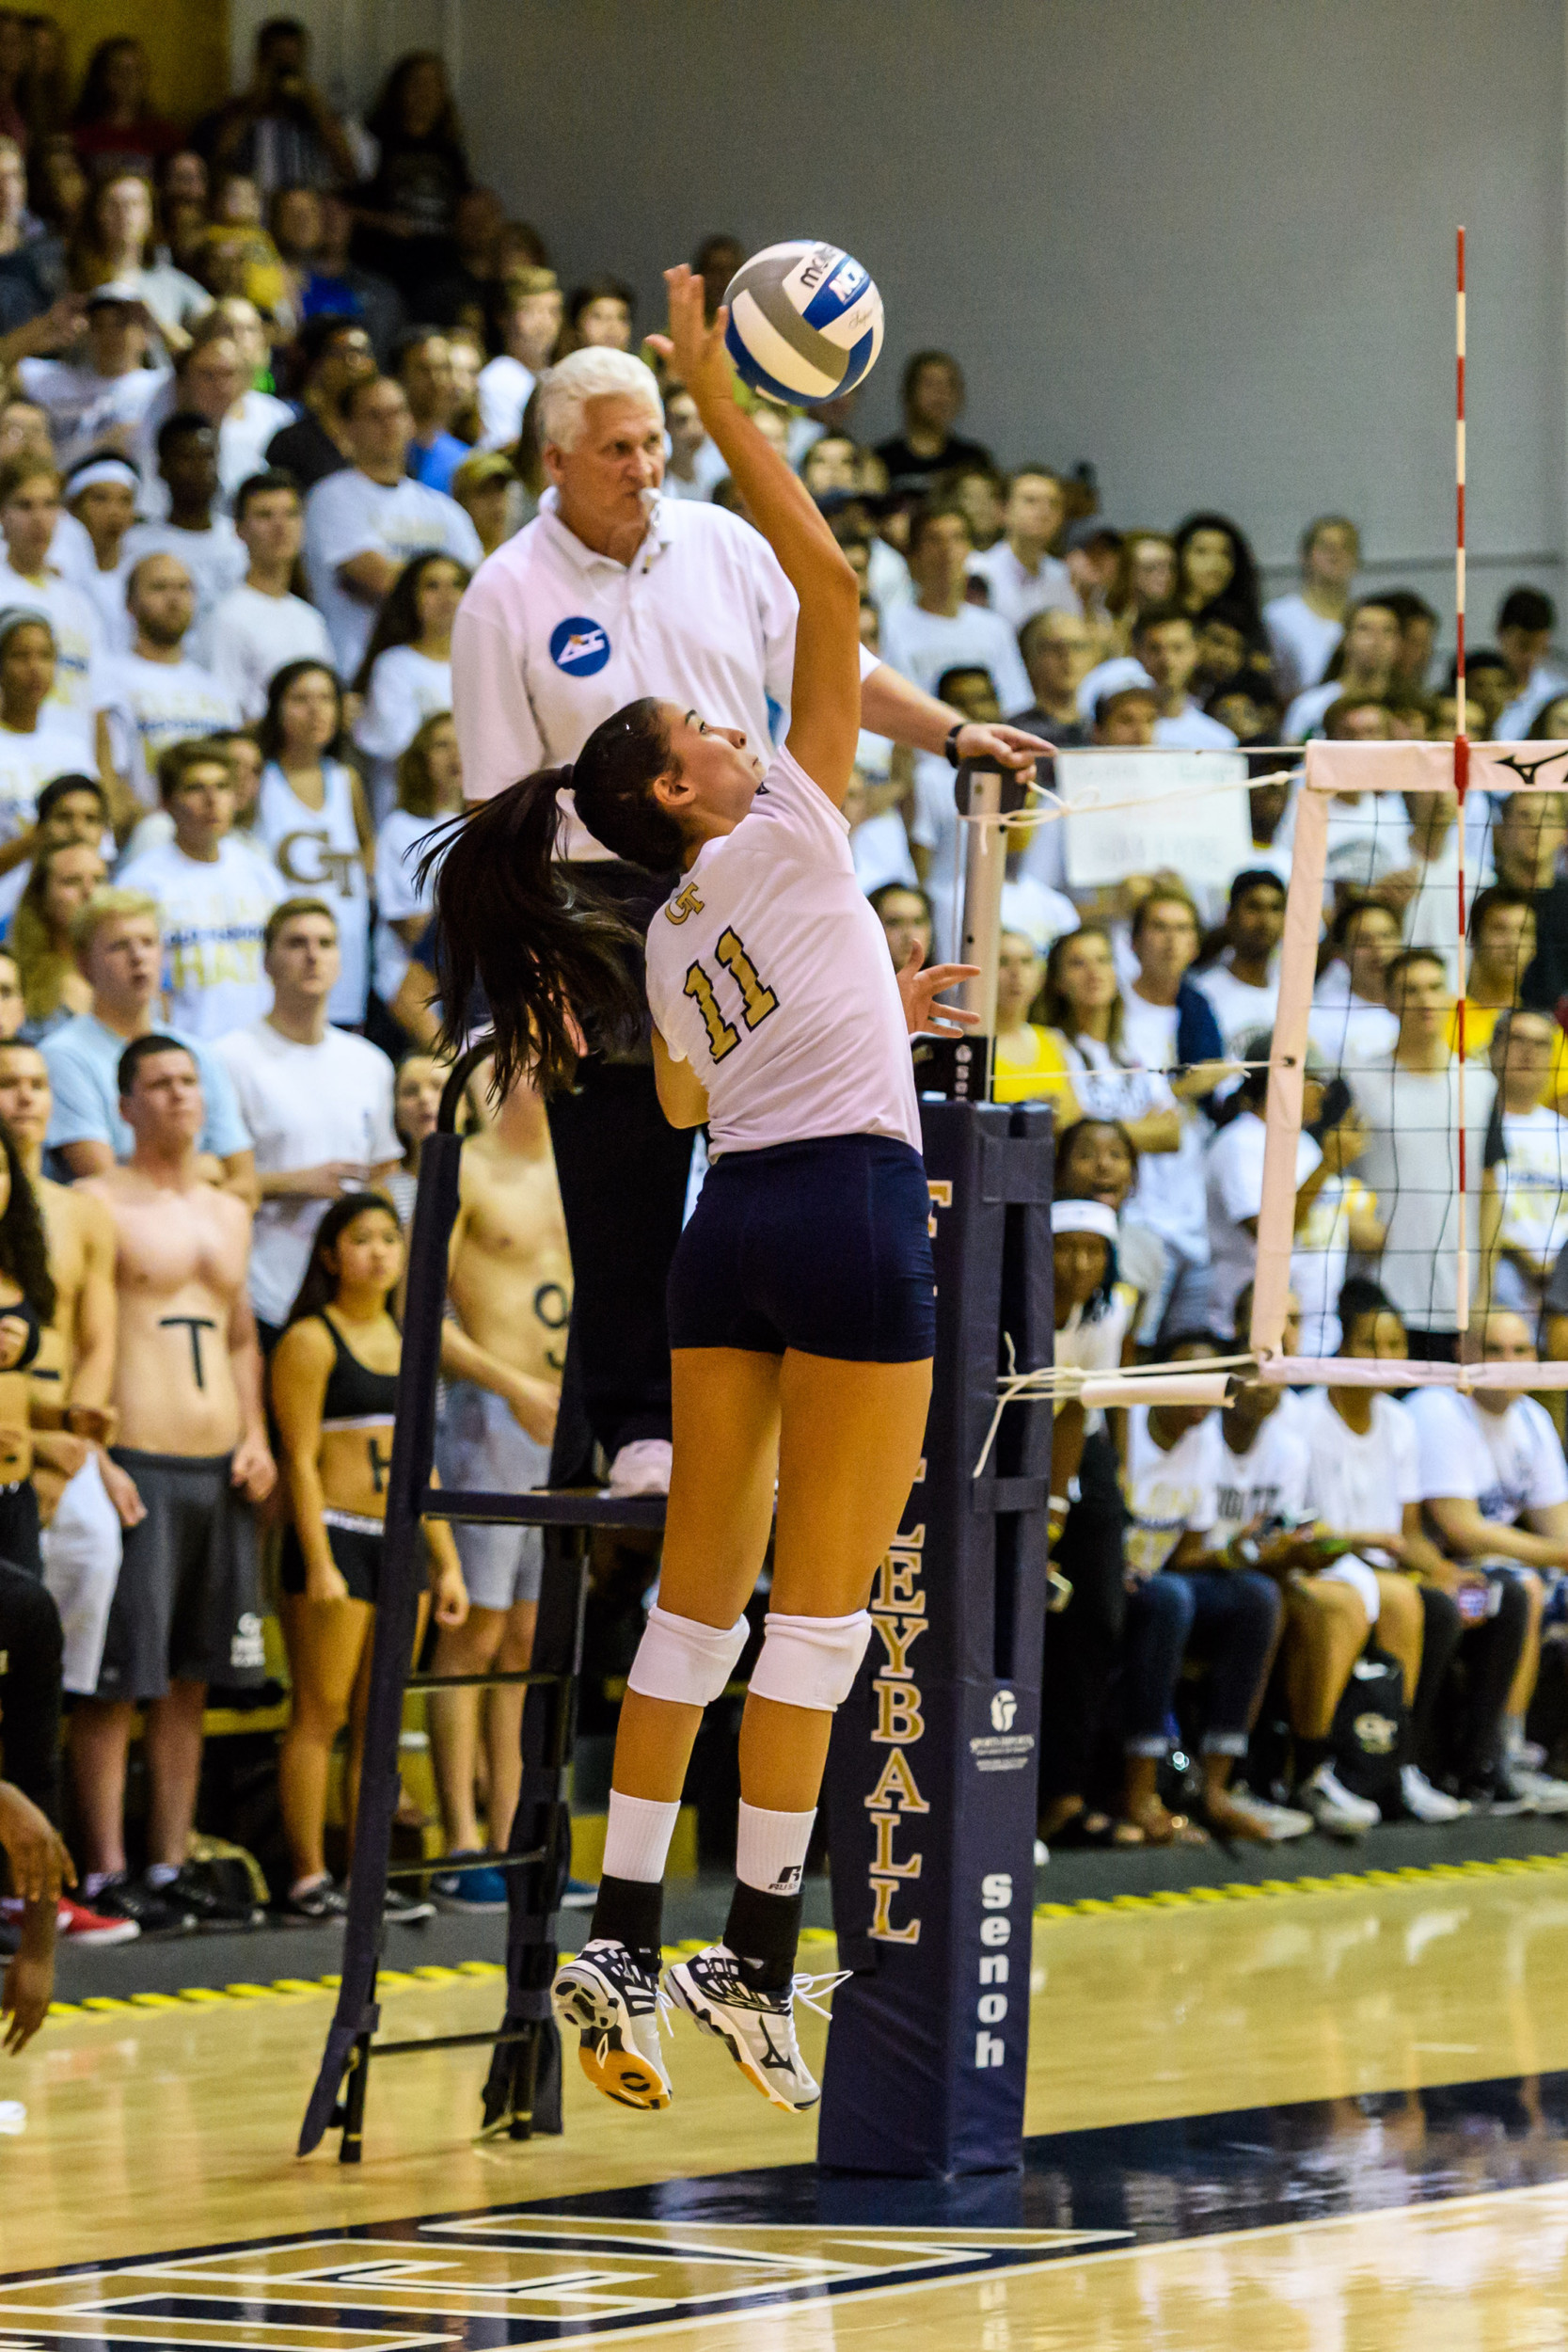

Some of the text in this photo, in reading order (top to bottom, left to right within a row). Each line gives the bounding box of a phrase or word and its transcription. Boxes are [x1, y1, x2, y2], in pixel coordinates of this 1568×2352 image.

[277, 829, 364, 898] GT
[665, 882, 705, 926] GT
[684, 925, 780, 1065] 11
[159, 1317, 216, 1390] T
[974, 1873, 1013, 2069] senoh
